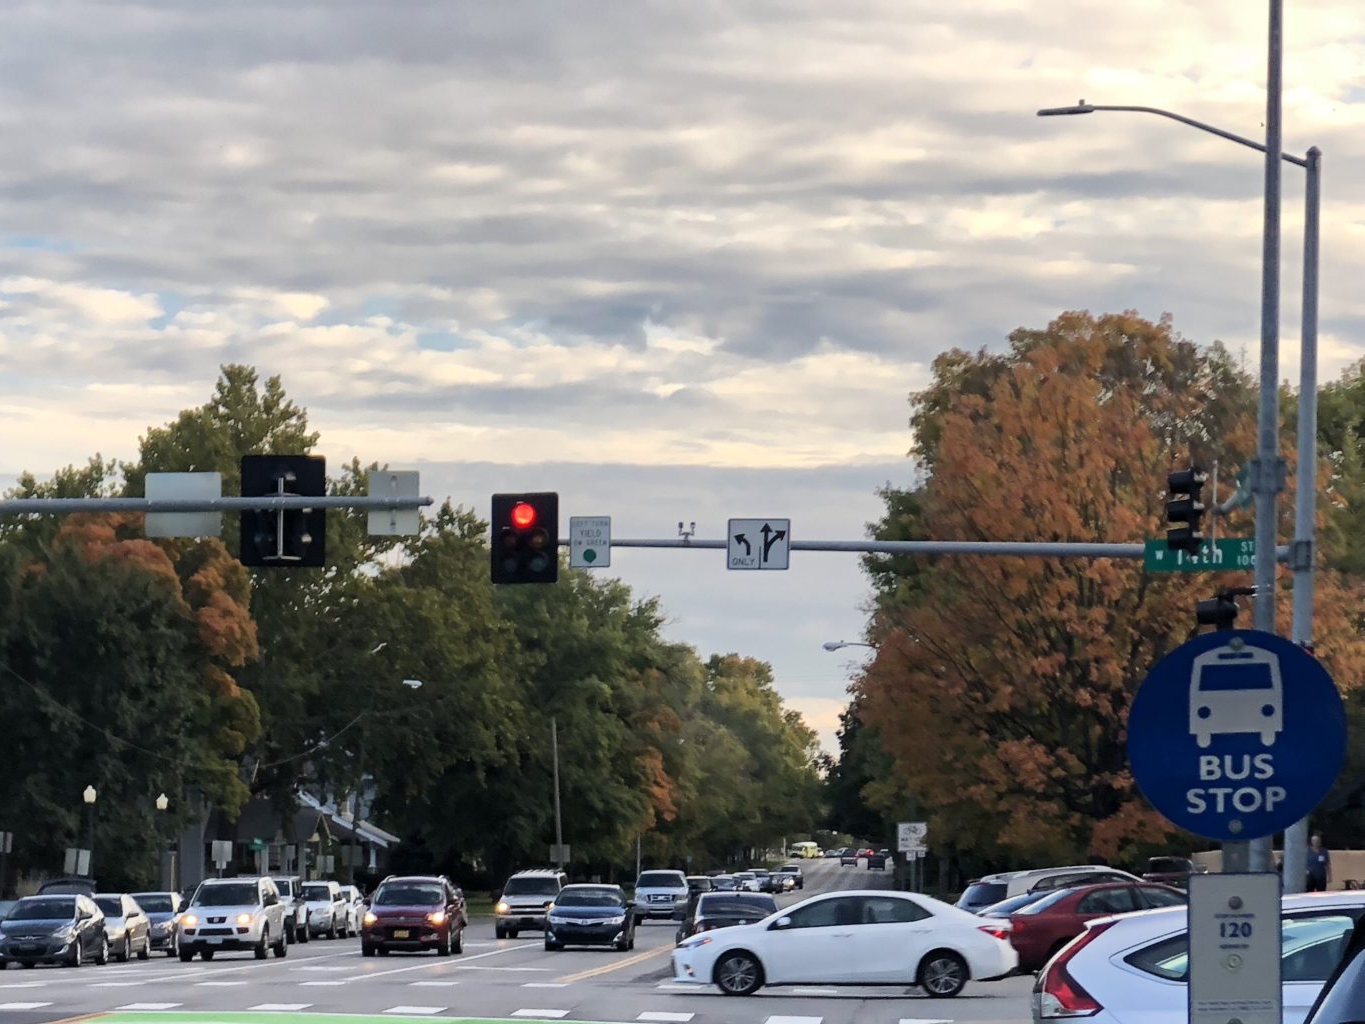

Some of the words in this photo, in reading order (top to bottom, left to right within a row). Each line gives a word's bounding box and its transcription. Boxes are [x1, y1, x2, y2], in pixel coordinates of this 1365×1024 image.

[732, 558, 755, 566] ONLY
[1155, 549, 1164, 560] W
[1199, 753, 1275, 781] BUS
[1186, 786, 1287, 814] STOP
[1219, 921, 1252, 938] 120
